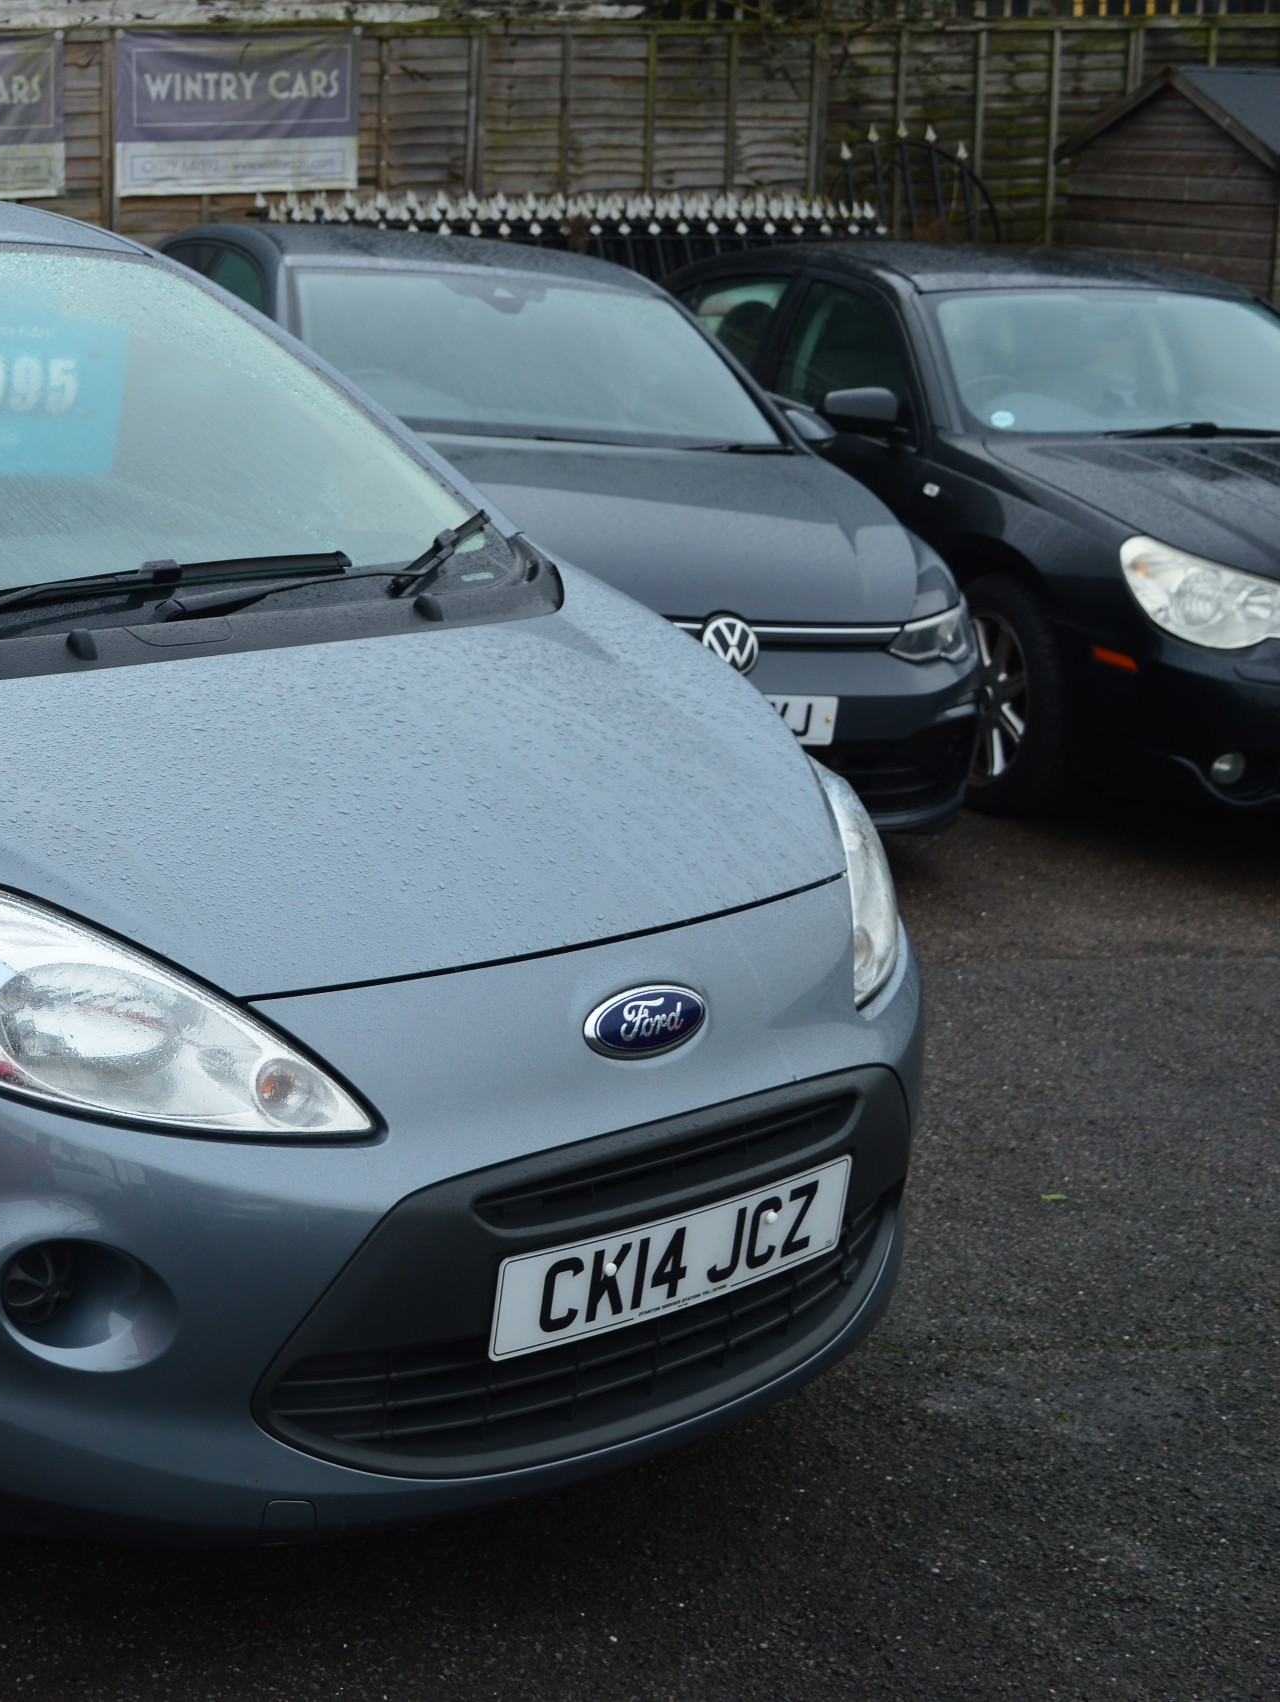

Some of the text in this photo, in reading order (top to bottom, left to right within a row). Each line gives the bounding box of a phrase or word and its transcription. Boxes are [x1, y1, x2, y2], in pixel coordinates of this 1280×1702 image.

[144, 69, 340, 102] WINTRY CARS
[621, 996, 684, 1042] Ford
[538, 1180, 819, 1333] CK14 JCZ
